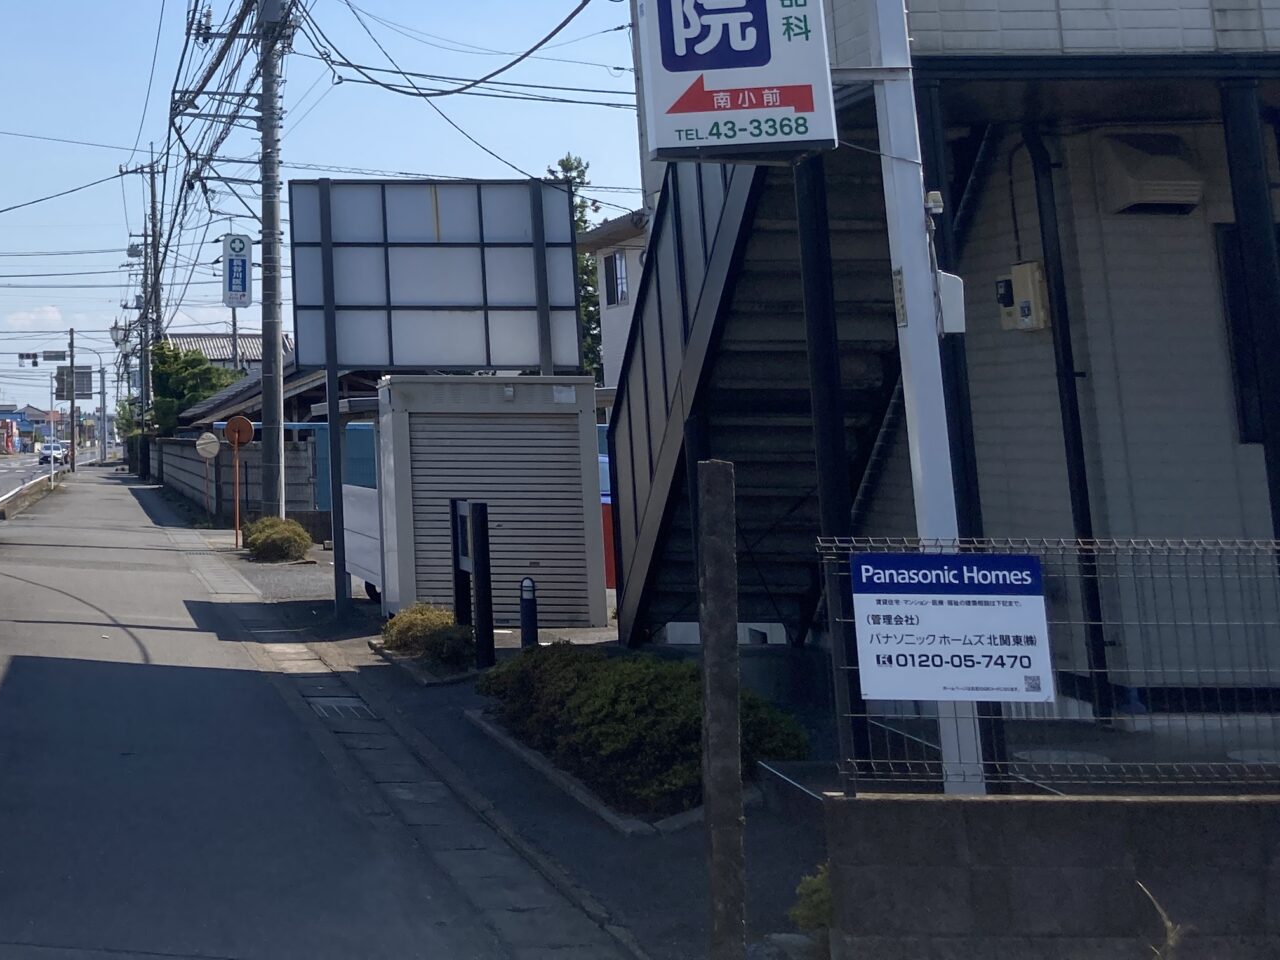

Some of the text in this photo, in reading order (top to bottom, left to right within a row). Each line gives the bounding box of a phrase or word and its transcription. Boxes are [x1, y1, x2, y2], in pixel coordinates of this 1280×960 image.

[712, 88, 781, 109] 南小前
[861, 565, 1032, 585] Panasonic Homes
[895, 654, 1032, 669] 0120-05-7470
